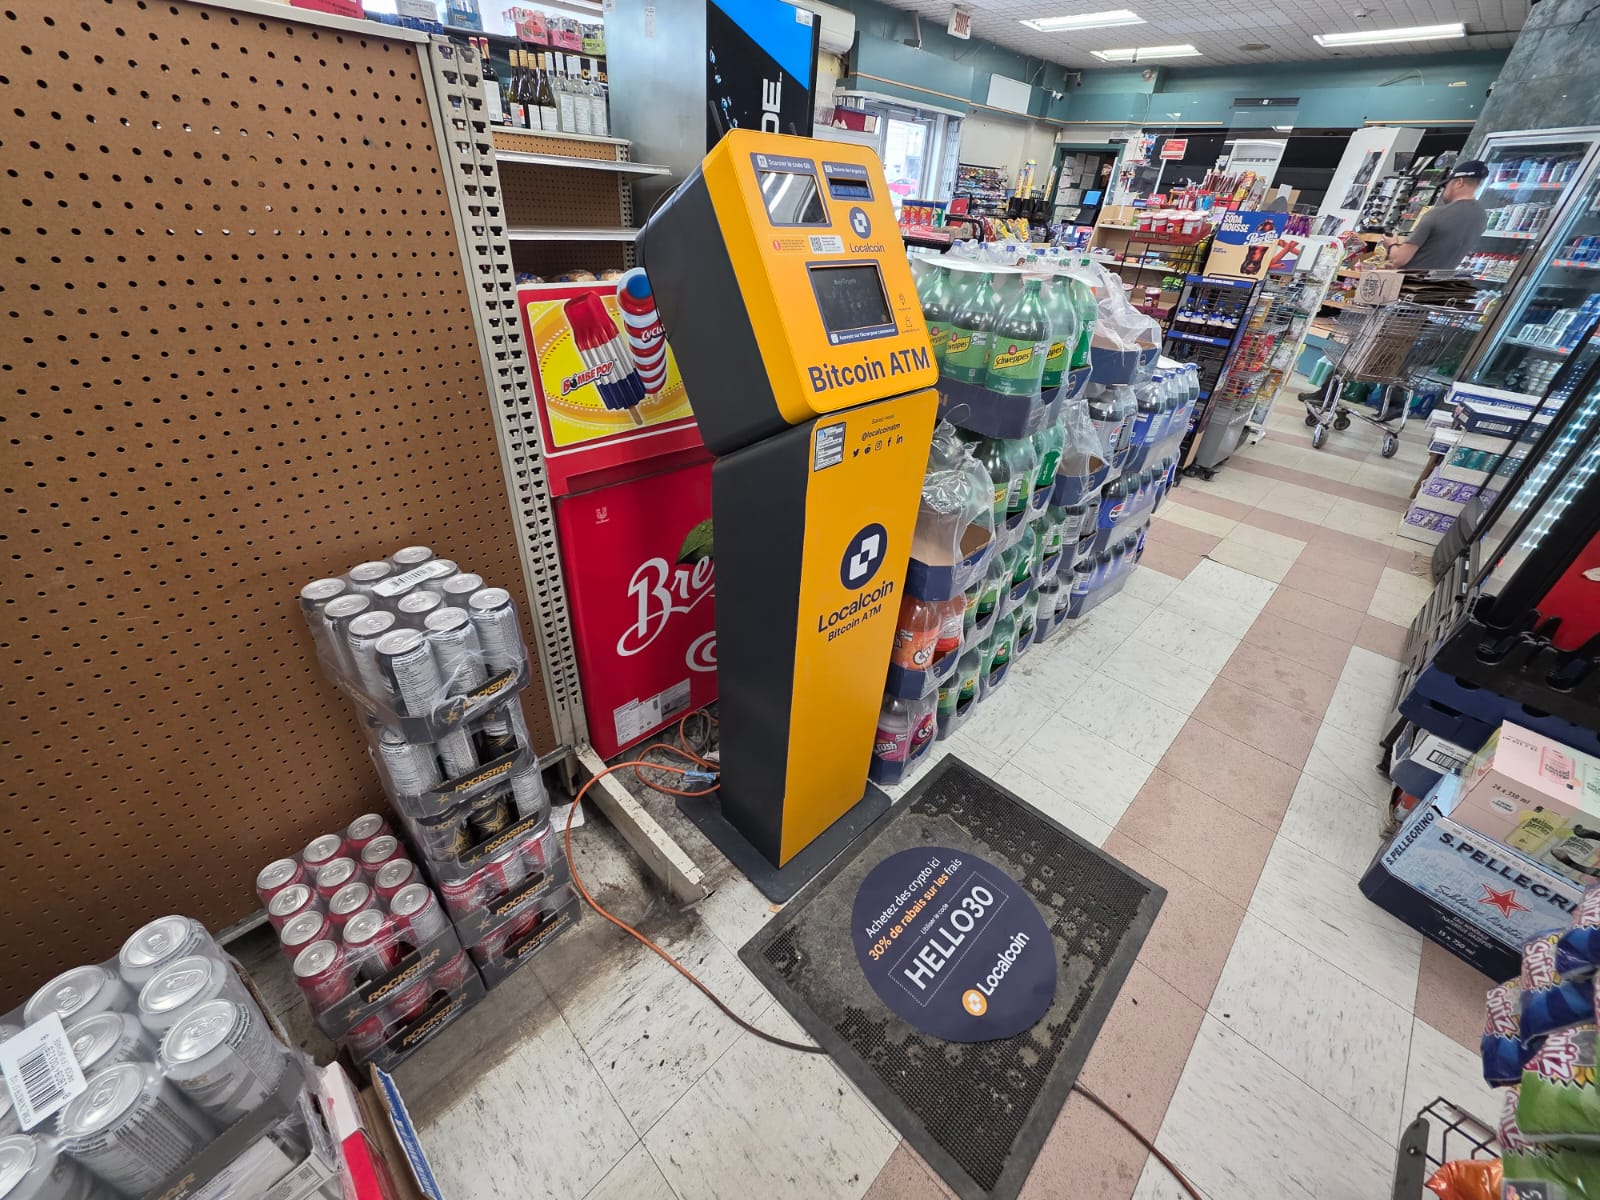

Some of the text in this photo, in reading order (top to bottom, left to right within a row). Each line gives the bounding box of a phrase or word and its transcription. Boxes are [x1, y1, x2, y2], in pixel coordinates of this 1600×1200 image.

[1220, 222, 1250, 233] MOUSSE
[1222, 213, 1243, 224] SODA
[850, 242, 886, 253] Localcoin
[596, 360, 614, 377] POP
[808, 346, 931, 393] Bitcoin ATM
[994, 352, 1029, 367] Schweppes
[861, 423, 901, 442] @localcoinatm
[817, 580, 894, 633] Localcoin
[827, 604, 883, 642] Bitcoin ATM
[455, 761, 513, 793] ROCKSTAR
[484, 819, 535, 854] ROCKSTAR
[1385, 812, 1435, 867] S.PELLEGRINO
[496, 874, 555, 917] ROCKSTAR
[865, 856, 941, 938] Achetez des crypto ici
[868, 857, 963, 961] 30% de rabais sur les frais
[518, 912, 570, 955] ROCKSTAR
[903, 885, 994, 991] HELLO30
[1452, 938, 1466, 949] 750
[368, 948, 441, 1003] ROCKSTAR
[976, 931, 1030, 997] Localcoin
[403, 992, 467, 1046] ROCKSTAR
